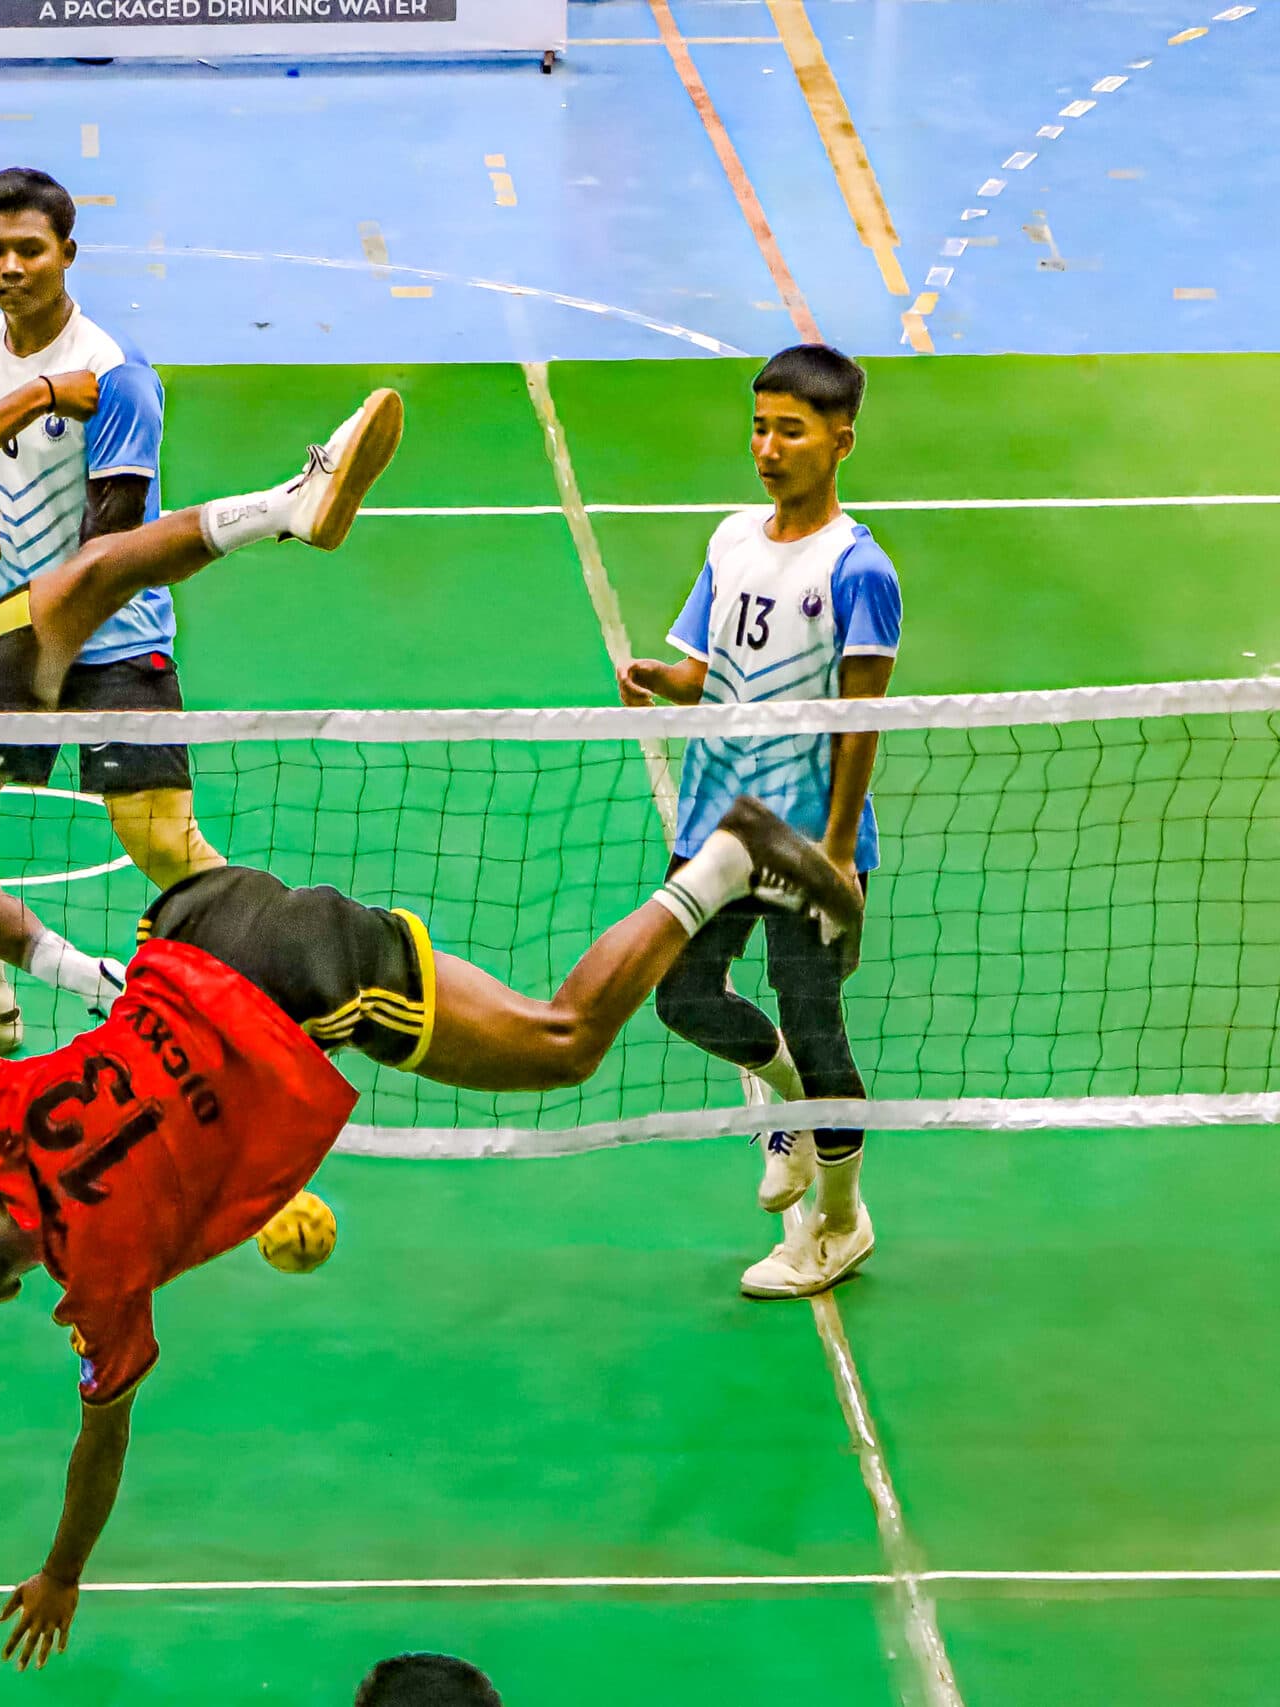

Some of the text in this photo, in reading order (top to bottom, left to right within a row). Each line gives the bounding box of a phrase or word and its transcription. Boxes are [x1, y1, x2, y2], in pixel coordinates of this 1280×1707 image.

[39, 0, 427, 20] A PACKAGED DRINKING WATER
[736, 592, 776, 650] 13
[25, 1053, 163, 1204] 13
